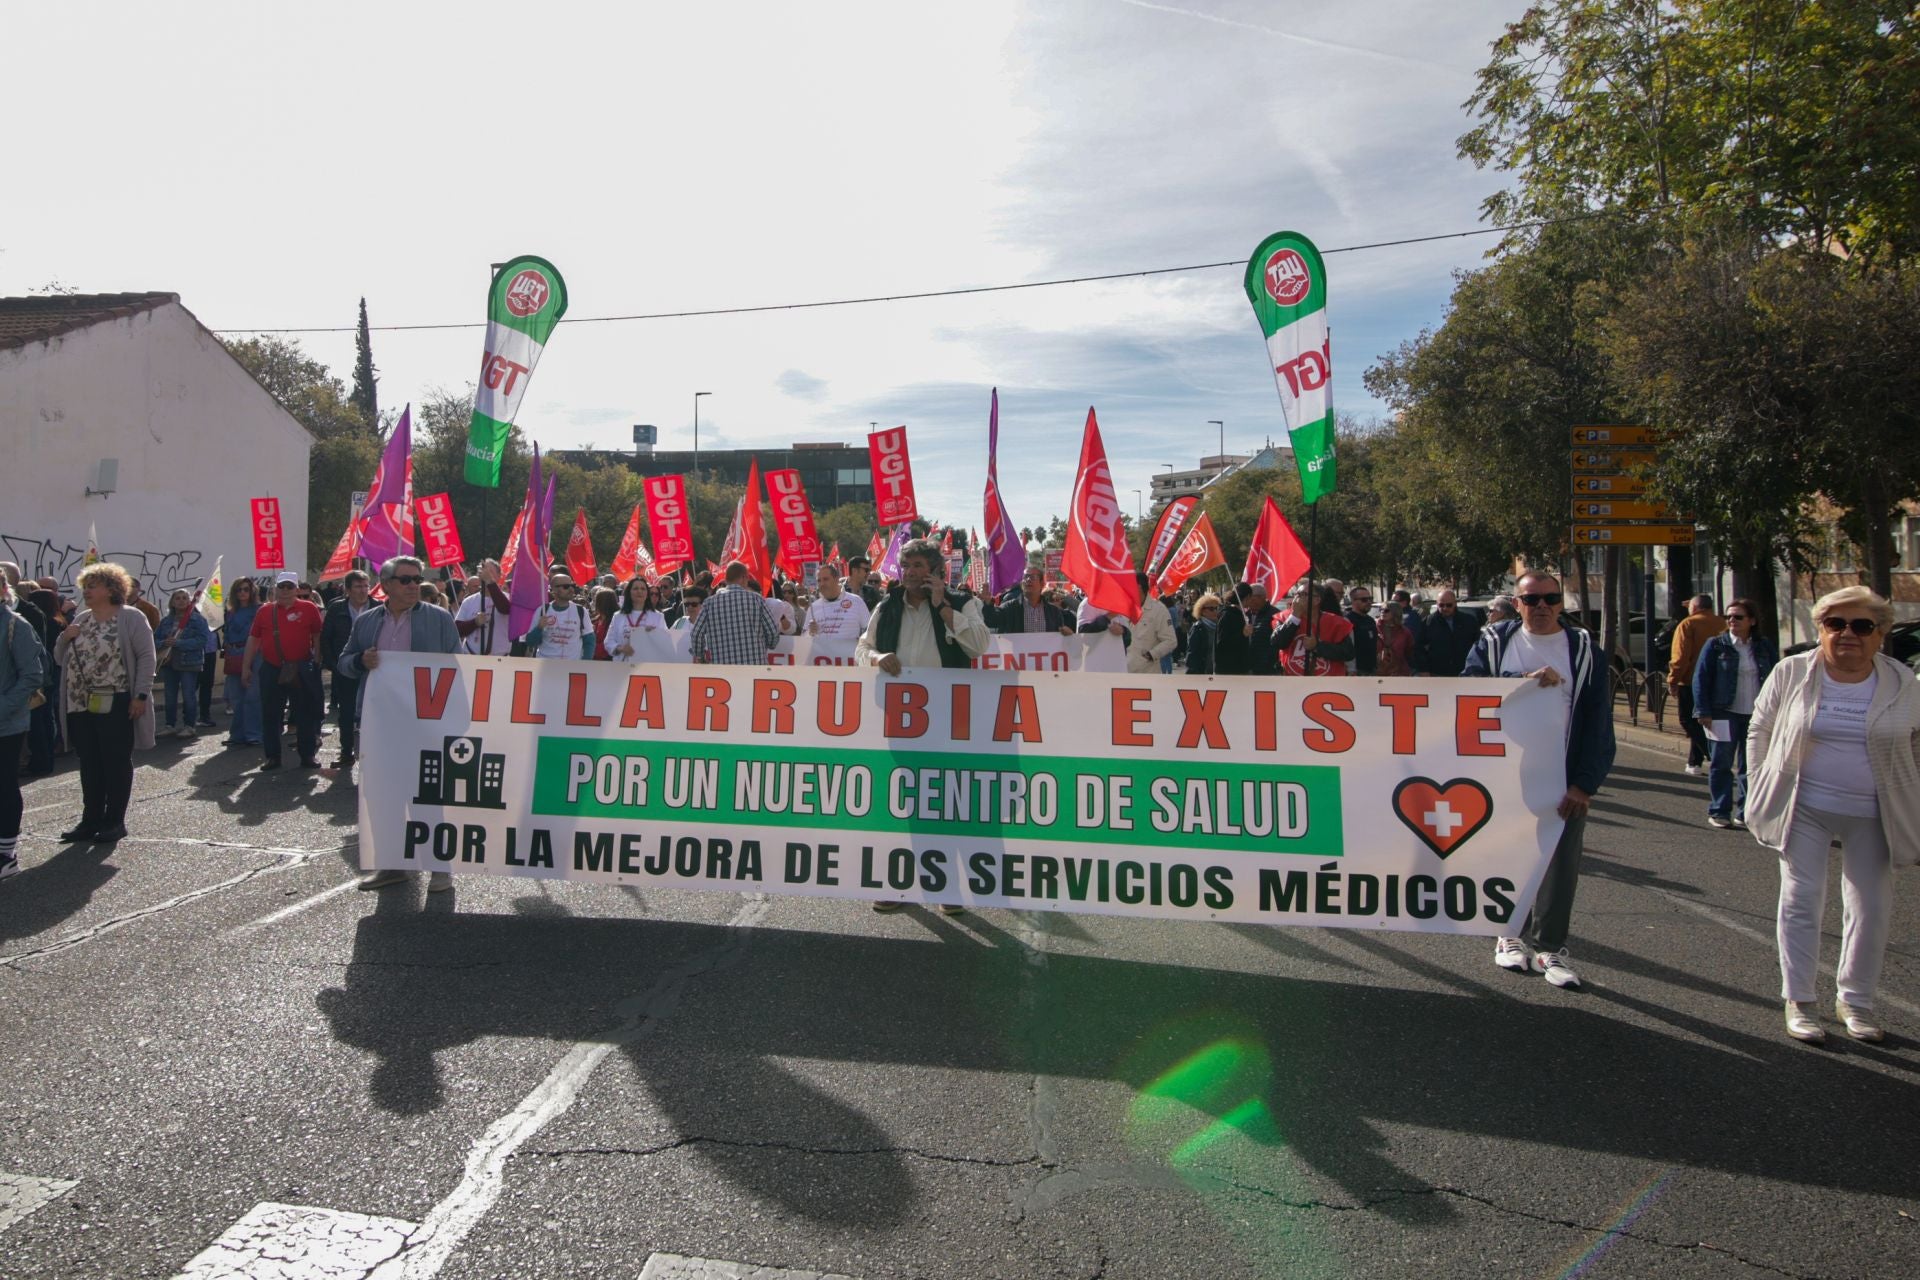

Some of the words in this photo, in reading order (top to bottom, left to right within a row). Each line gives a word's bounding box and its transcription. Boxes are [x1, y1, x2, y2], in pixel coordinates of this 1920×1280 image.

[513, 273, 546, 299] UGT
[877, 431, 906, 497] UGT
[258, 501, 278, 548] UGT
[421, 496, 451, 546] UGT
[651, 479, 682, 538] UGT
[774, 473, 808, 537] UGT
[413, 667, 1043, 744] VILLARRUBIA
[1110, 687, 1507, 758] EXISTE
[566, 752, 650, 808] POR
[663, 756, 720, 811] UN
[733, 760, 873, 819] NUEVO
[887, 766, 1059, 827] CENTRO
[1075, 773, 1135, 832] DE
[1149, 776, 1310, 840] SALUD
[403, 820, 488, 865] POR
[505, 827, 555, 869] LA
[573, 831, 763, 882] MEJORA
[783, 841, 840, 887] DE
[860, 846, 948, 893] LOS
[968, 851, 1235, 911] SERVICIOS
[1258, 860, 1517, 925] MÉDICOS
